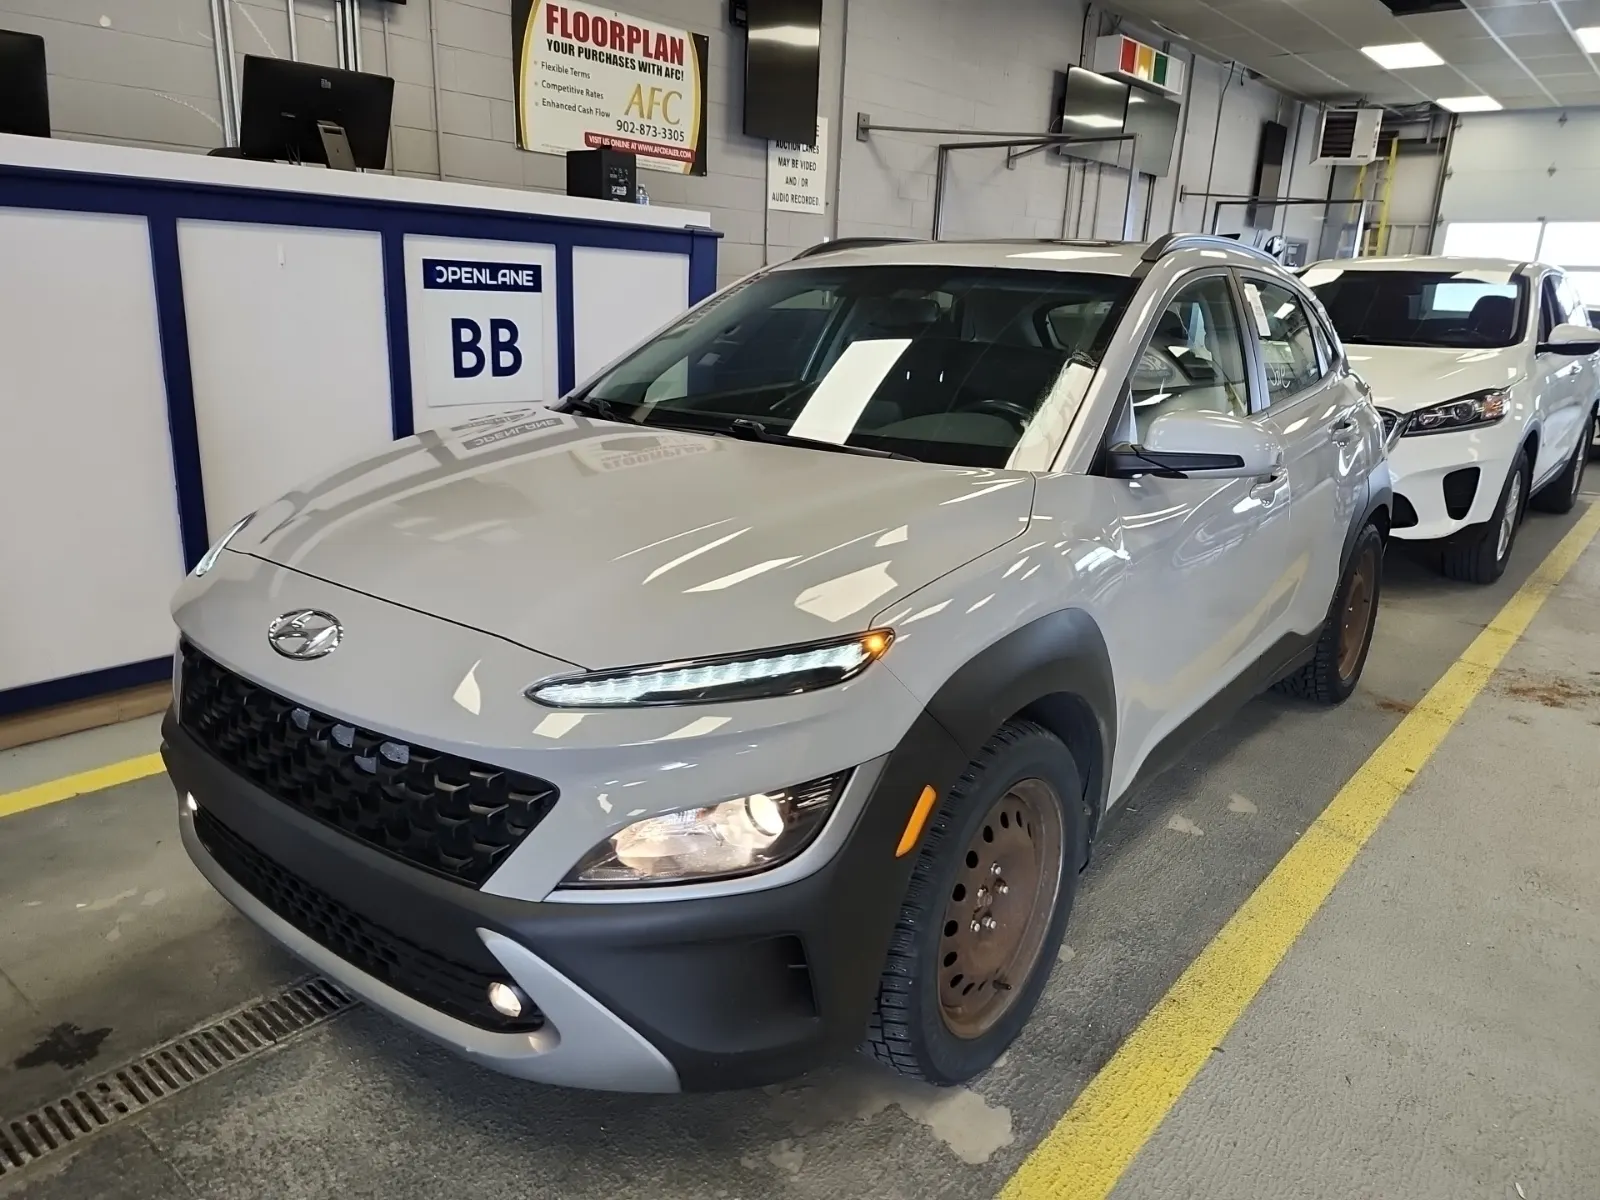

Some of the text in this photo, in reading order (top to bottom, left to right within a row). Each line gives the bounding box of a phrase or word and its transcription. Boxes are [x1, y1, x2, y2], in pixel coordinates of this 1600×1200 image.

[545, 2, 684, 67] FLOORPLAN
[541, 61, 591, 79] Flexible Terms
[546, 38, 684, 81] YOUR PURCHASES WITH AFC!
[541, 79, 604, 100] Competitive Rates
[542, 98, 611, 118] Enhanced Cash Flow
[624, 83, 682, 125] AFC
[616, 119, 685, 142] 902-873-3305
[589, 134, 601, 144] VISIT
[610, 139, 630, 149] ONLINE
[631, 142, 637, 150] AT
[637, 143, 692, 159] WWW.AFCDEALER.COM
[776, 140, 819, 154] AUCTION LANES
[778, 156, 817, 171] MAY BE VIDEO
[785, 176, 797, 186] AND
[801, 178, 809, 187] OR
[772, 192, 820, 206] AUDIO RECORDED.
[435, 265, 534, 287] OPENLANE
[451, 317, 523, 379] BB
